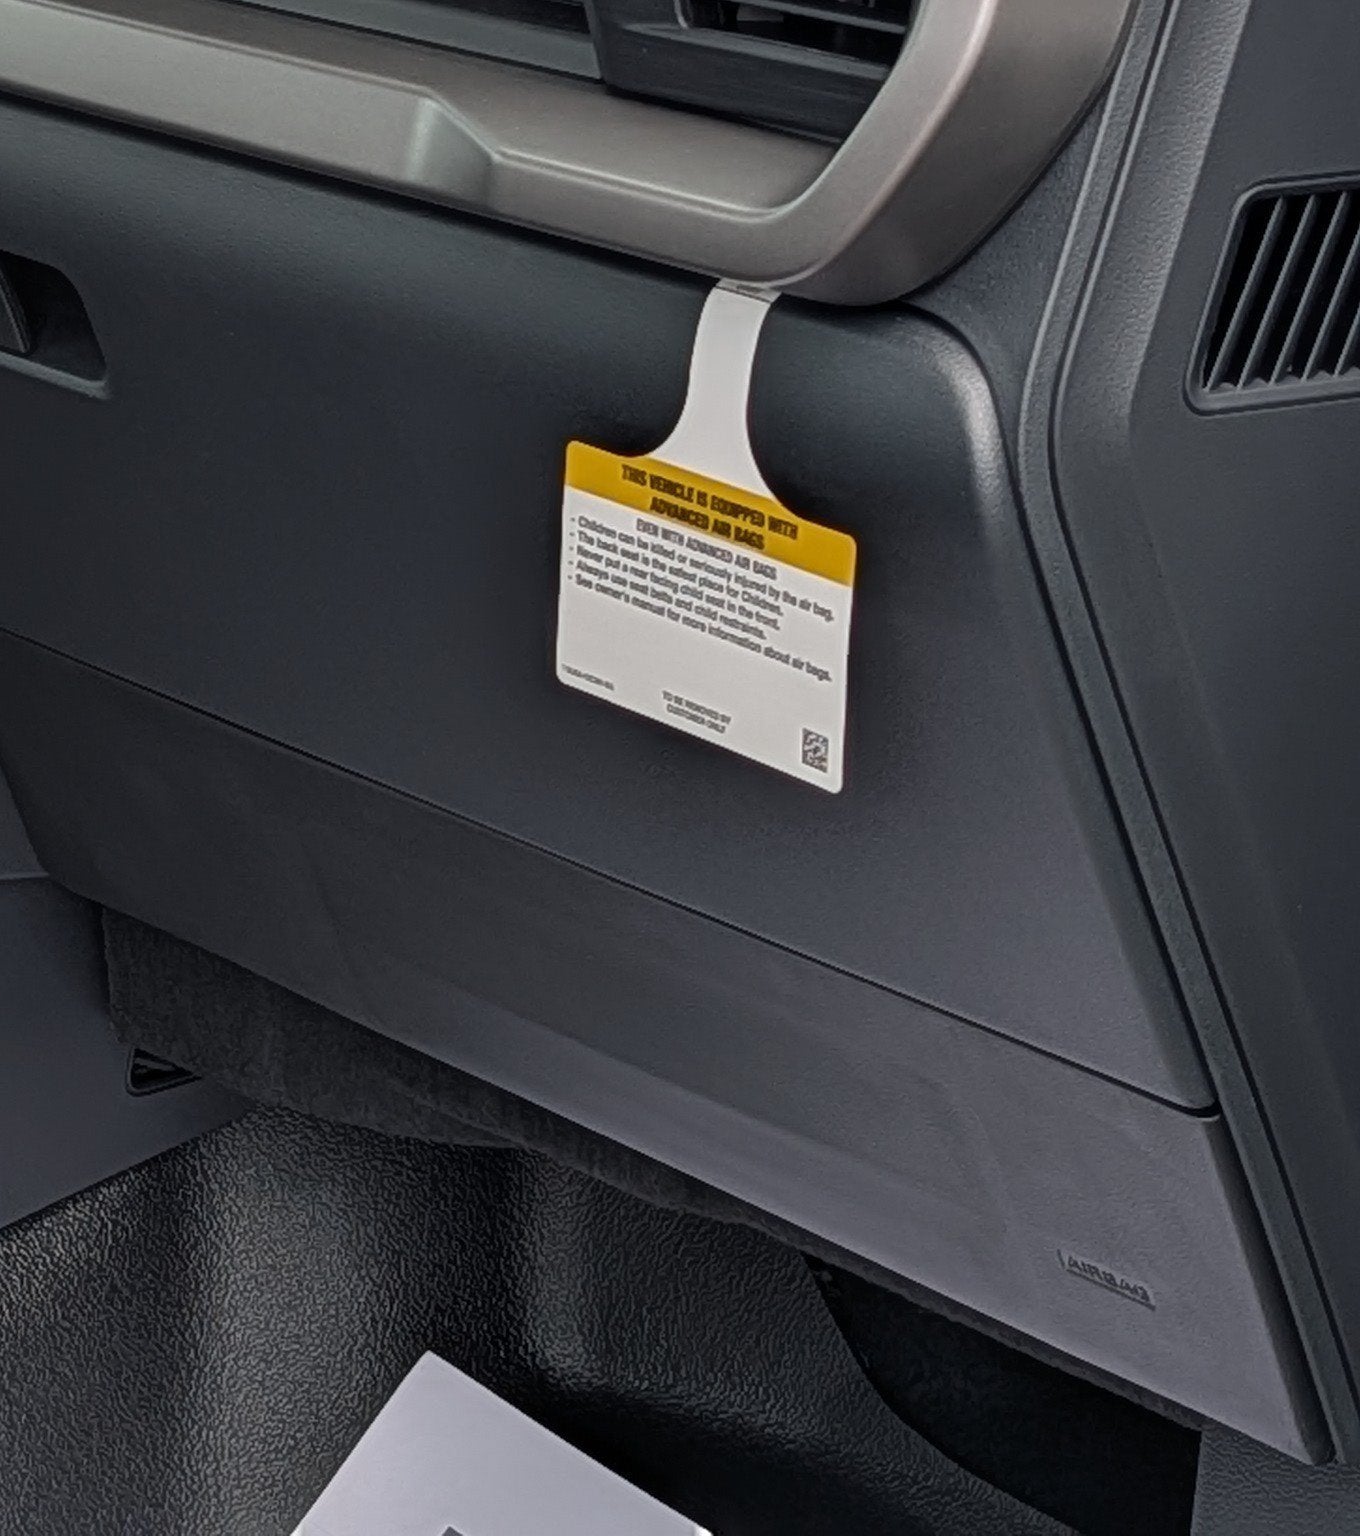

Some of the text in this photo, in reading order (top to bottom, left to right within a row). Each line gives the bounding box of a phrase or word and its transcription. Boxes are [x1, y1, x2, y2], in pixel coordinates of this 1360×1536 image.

[622, 464, 797, 539] THIS VEHICLE IS EQUIPPED WITH
[650, 495, 764, 549] ADVANCED AIR BAGS
[579, 515, 833, 622] Children can be killed or seriously injured by the air bag.
[637, 518, 776, 580] EVEN WITH ADVANCED AIR BAGS
[576, 573, 831, 683] See owner's manual for more information about air bags.
